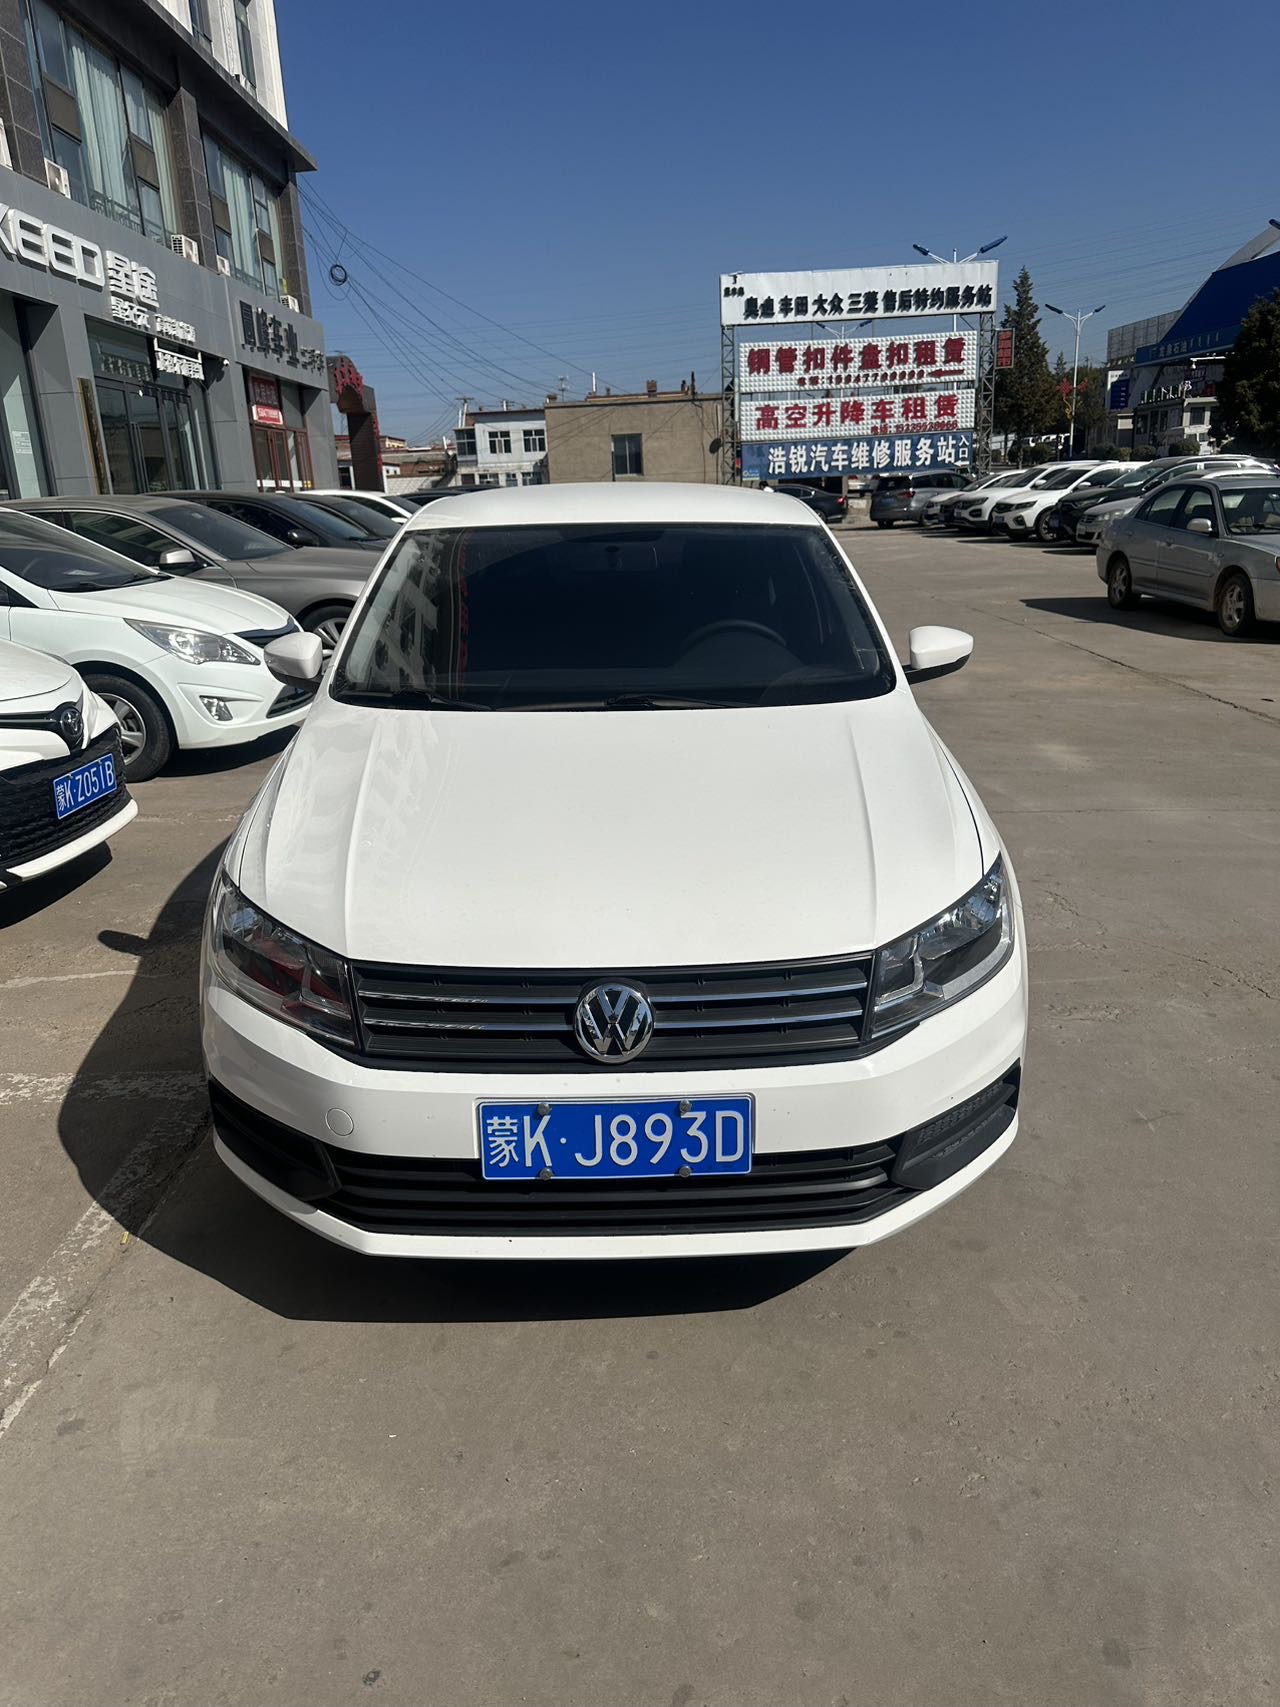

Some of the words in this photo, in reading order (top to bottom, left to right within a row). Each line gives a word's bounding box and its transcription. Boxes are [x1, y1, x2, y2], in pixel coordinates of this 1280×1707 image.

[106, 250, 160, 308] 星途
[755, 395, 958, 430] 高空升降车租赁
[768, 436, 956, 475] 浩锐汽车维修服务站
[958, 435, 970, 460] 入口
